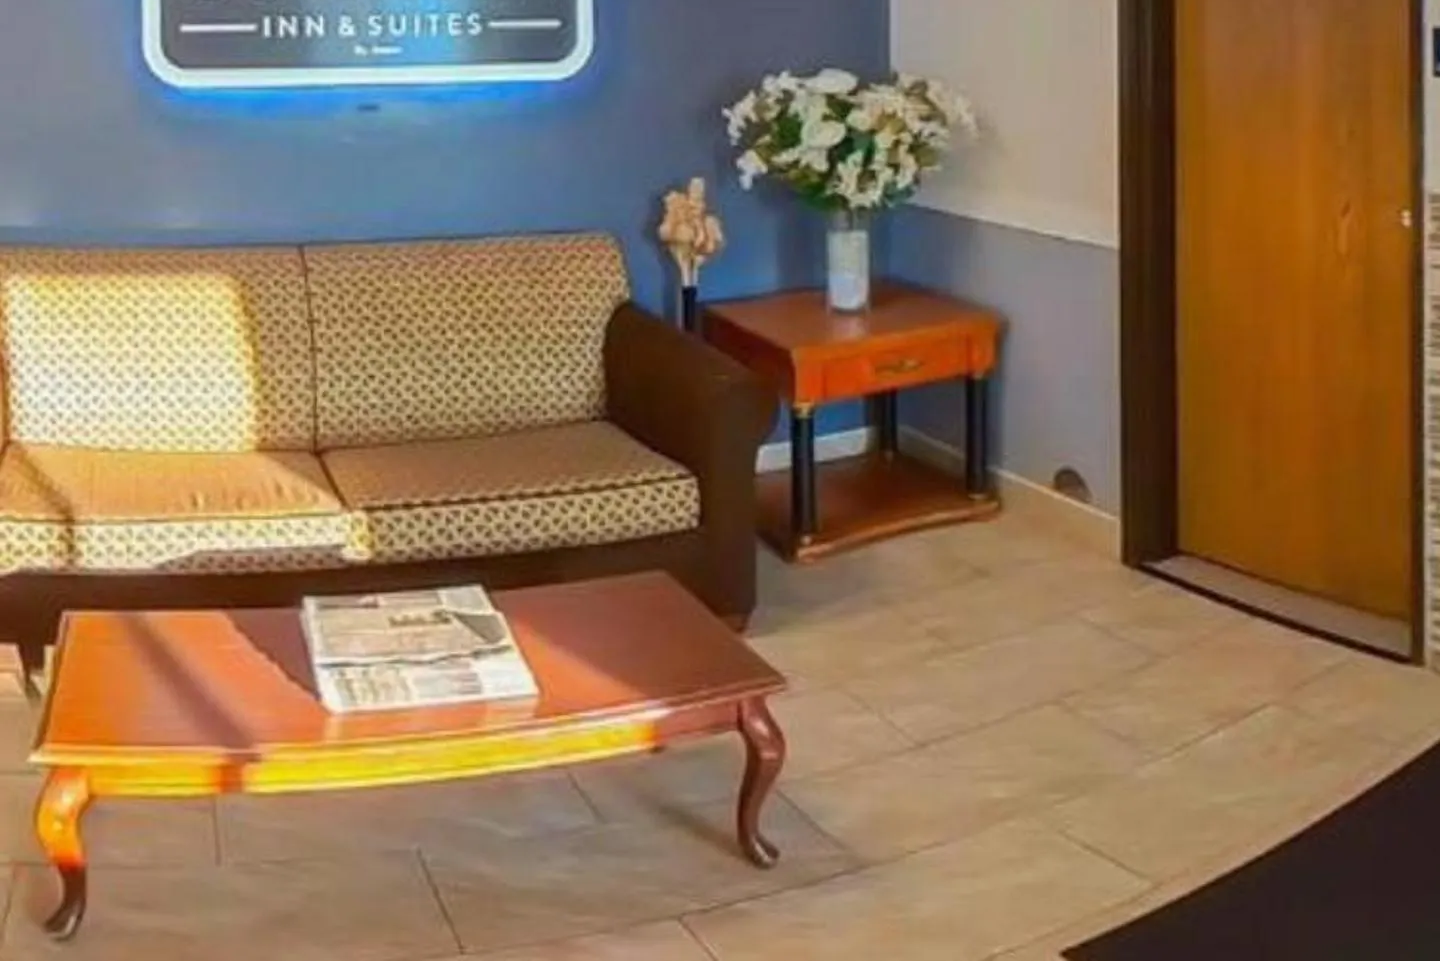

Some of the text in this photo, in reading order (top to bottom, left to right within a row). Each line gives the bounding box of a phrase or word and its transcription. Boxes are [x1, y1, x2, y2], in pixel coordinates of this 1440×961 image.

[263, 12, 482, 38] INN & SUITES
